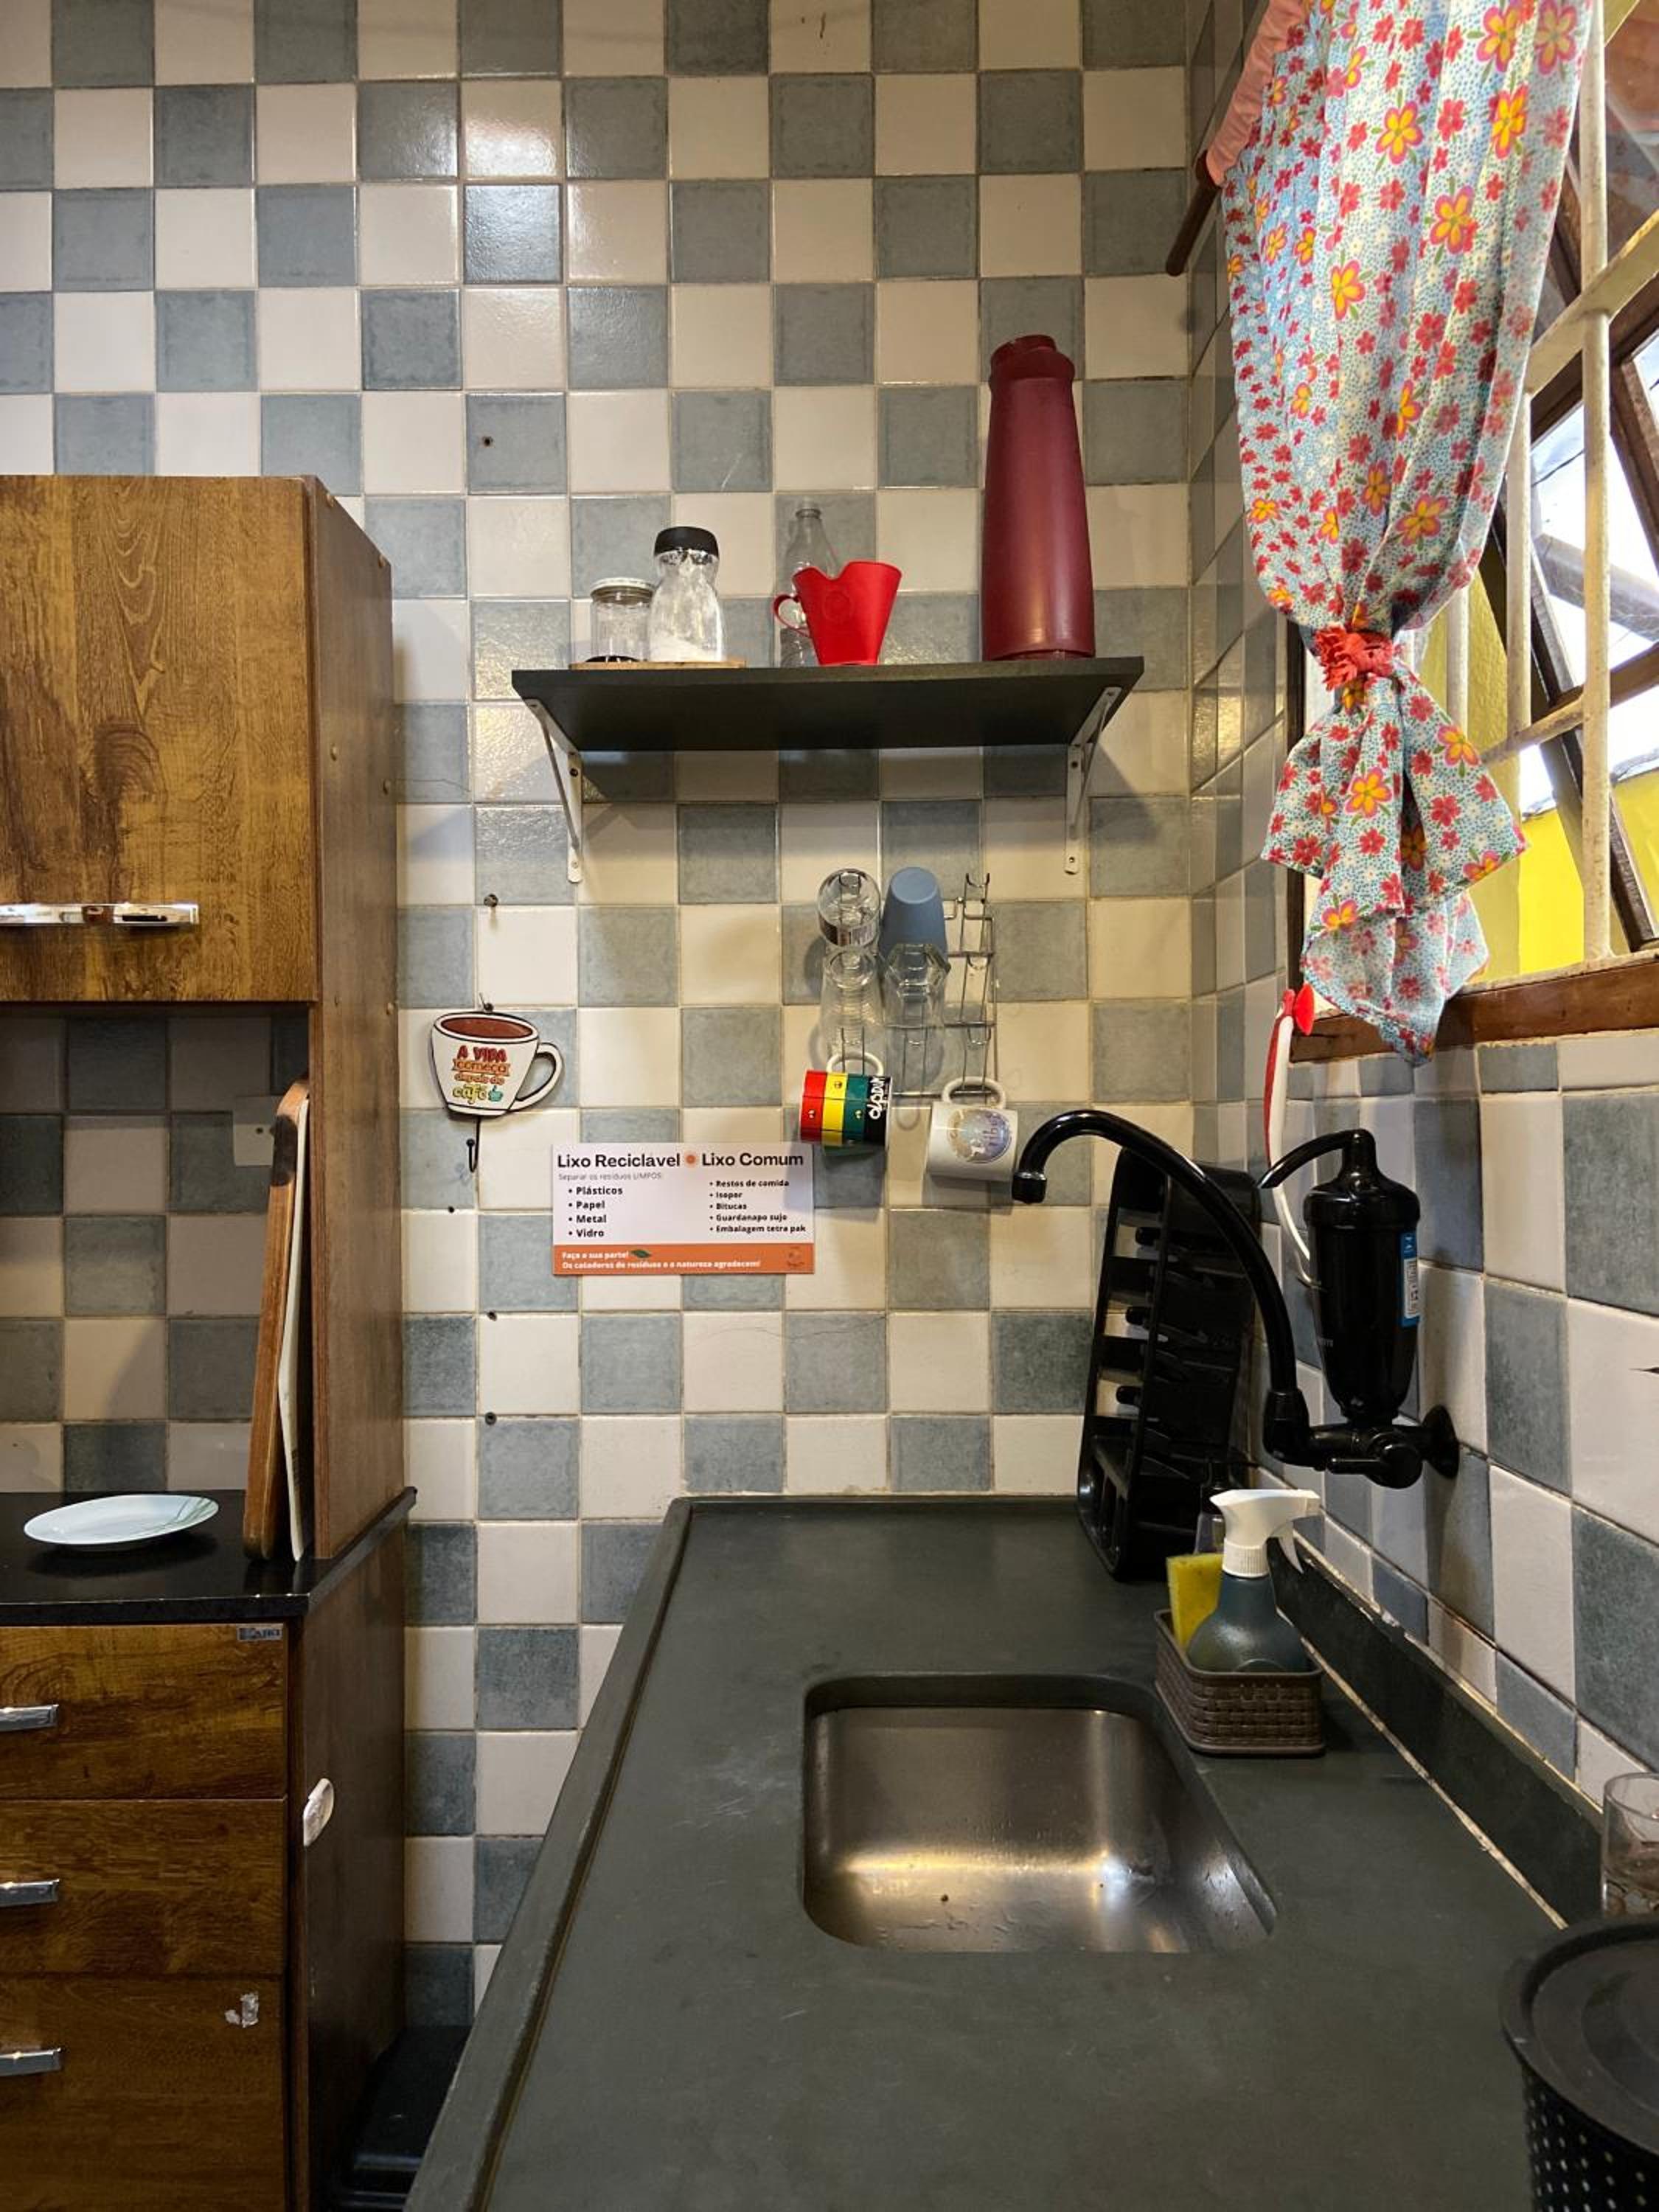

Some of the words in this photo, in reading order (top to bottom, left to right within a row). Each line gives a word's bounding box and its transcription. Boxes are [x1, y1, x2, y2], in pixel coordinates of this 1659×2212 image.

[457, 1046, 468, 1059] A
[473, 1047, 507, 1062] VIDA
[453, 1084, 487, 1104] café
[557, 1154, 591, 1167] Lixo
[702, 1152, 735, 1166] Lixo
[740, 1152, 803, 1166] Comum
[576, 1186, 622, 1195] Plásticos
[716, 1192, 742, 1200] Isopor
[576, 1200, 605, 1211] Papel
[576, 1214, 606, 1223] Metal
[716, 1214, 767, 1222] Guardanapo
[769, 1213, 787, 1222] sujo
[576, 1228, 604, 1237] Vidro
[716, 1225, 764, 1234] Embalagem
[790, 1224, 806, 1234] pak
[615, 1261, 626, 1269] de
